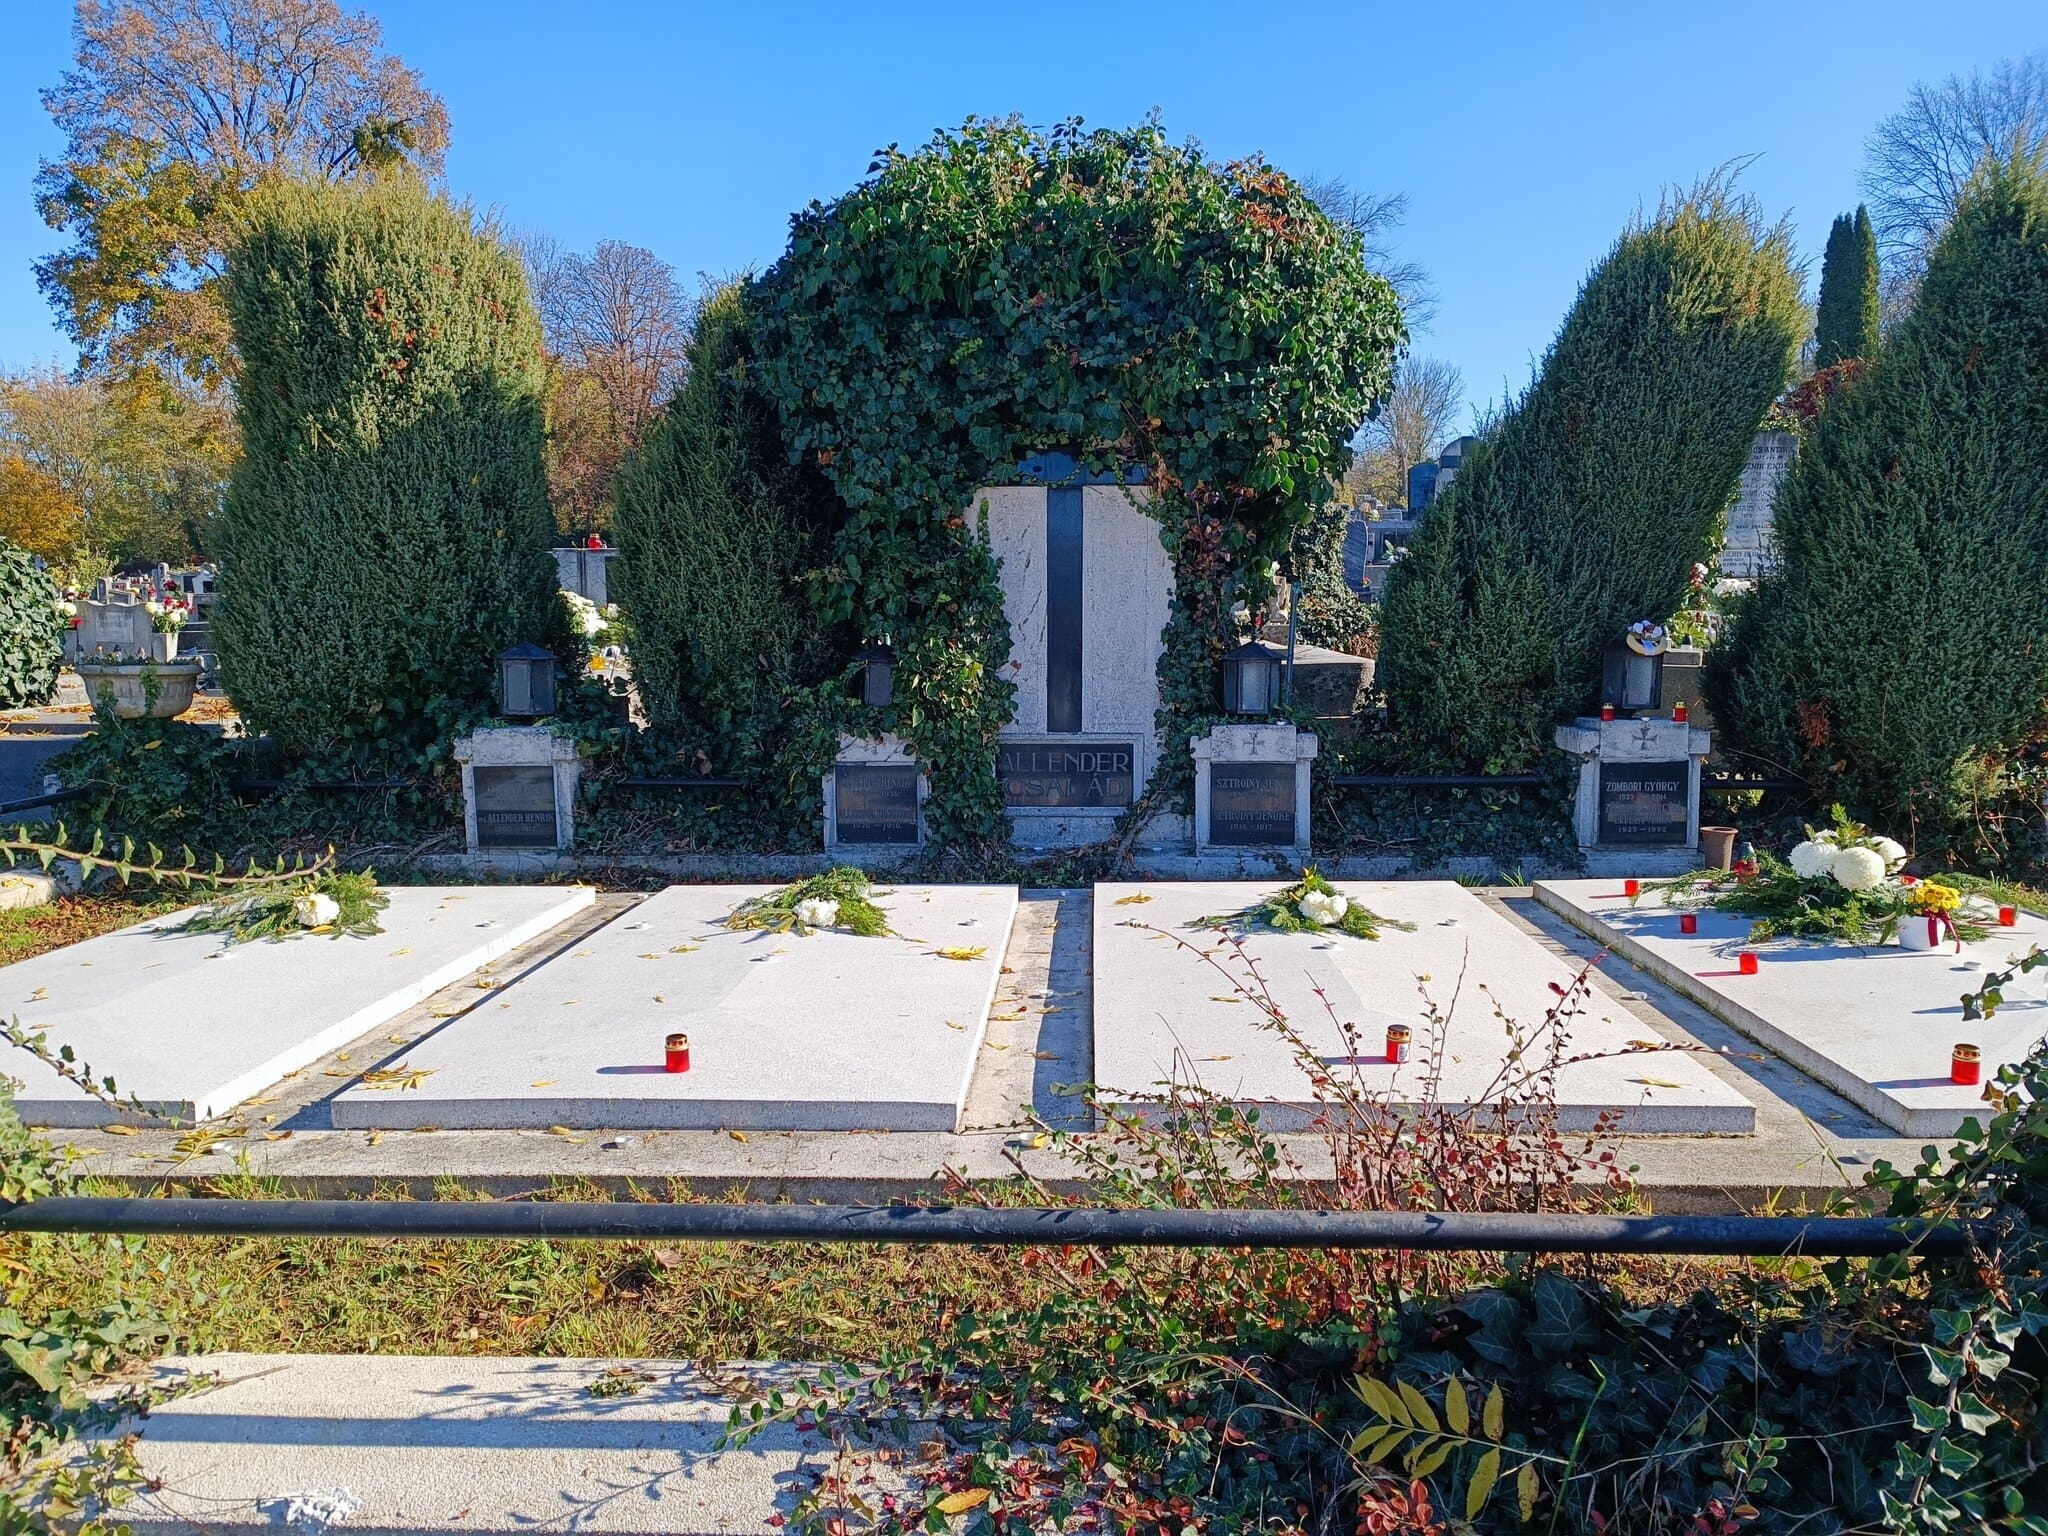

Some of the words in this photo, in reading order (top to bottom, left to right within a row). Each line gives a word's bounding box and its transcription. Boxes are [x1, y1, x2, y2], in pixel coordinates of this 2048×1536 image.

[1001, 752, 1129, 772] ALLENDER
[1004, 773, 1125, 797] CSALÁD
[1606, 781, 1642, 792] ZOMBORI
[1644, 779, 1680, 792] GYÖRGY
[488, 813, 522, 823] ALLENDER
[525, 813, 554, 823] HENRIK
